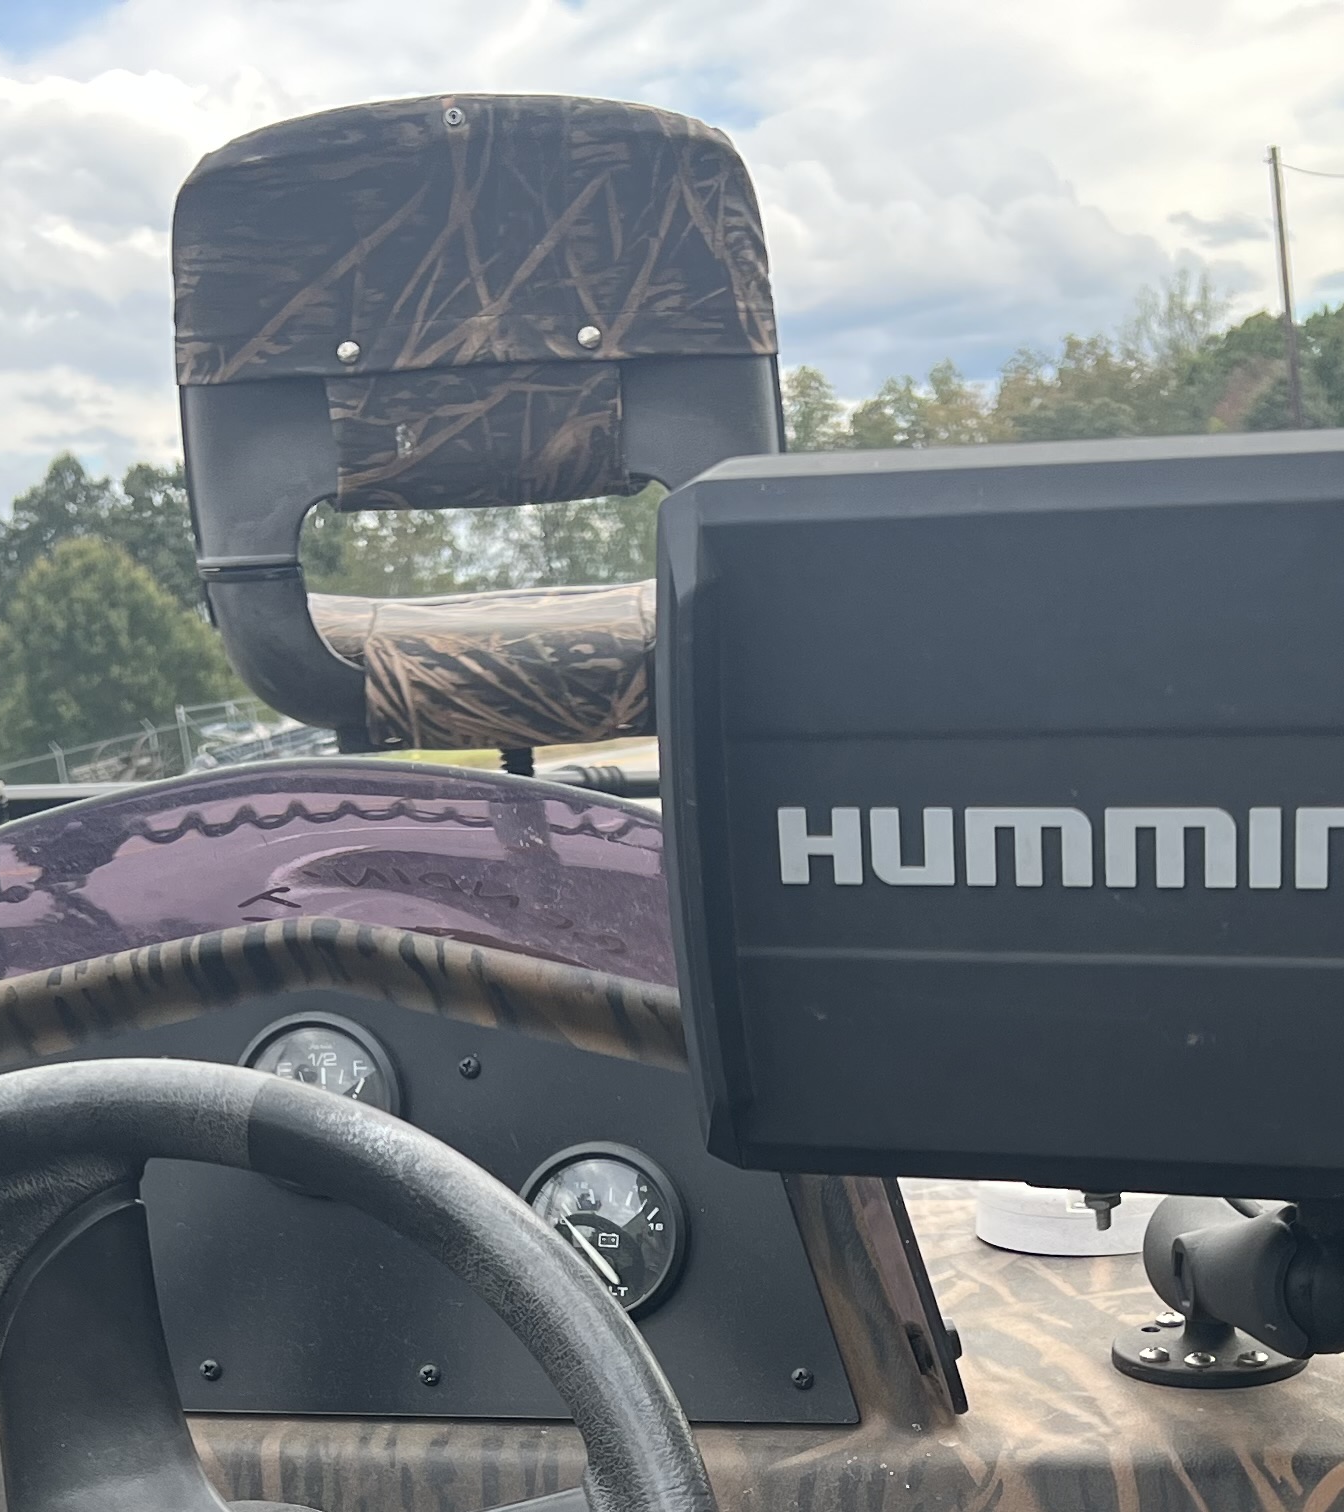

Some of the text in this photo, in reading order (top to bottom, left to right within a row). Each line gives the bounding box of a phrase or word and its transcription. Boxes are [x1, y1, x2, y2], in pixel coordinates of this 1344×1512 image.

[308, 1052, 337, 1066] 1/2
[277, 1062, 293, 1079] E
[353, 1060, 368, 1077] F
